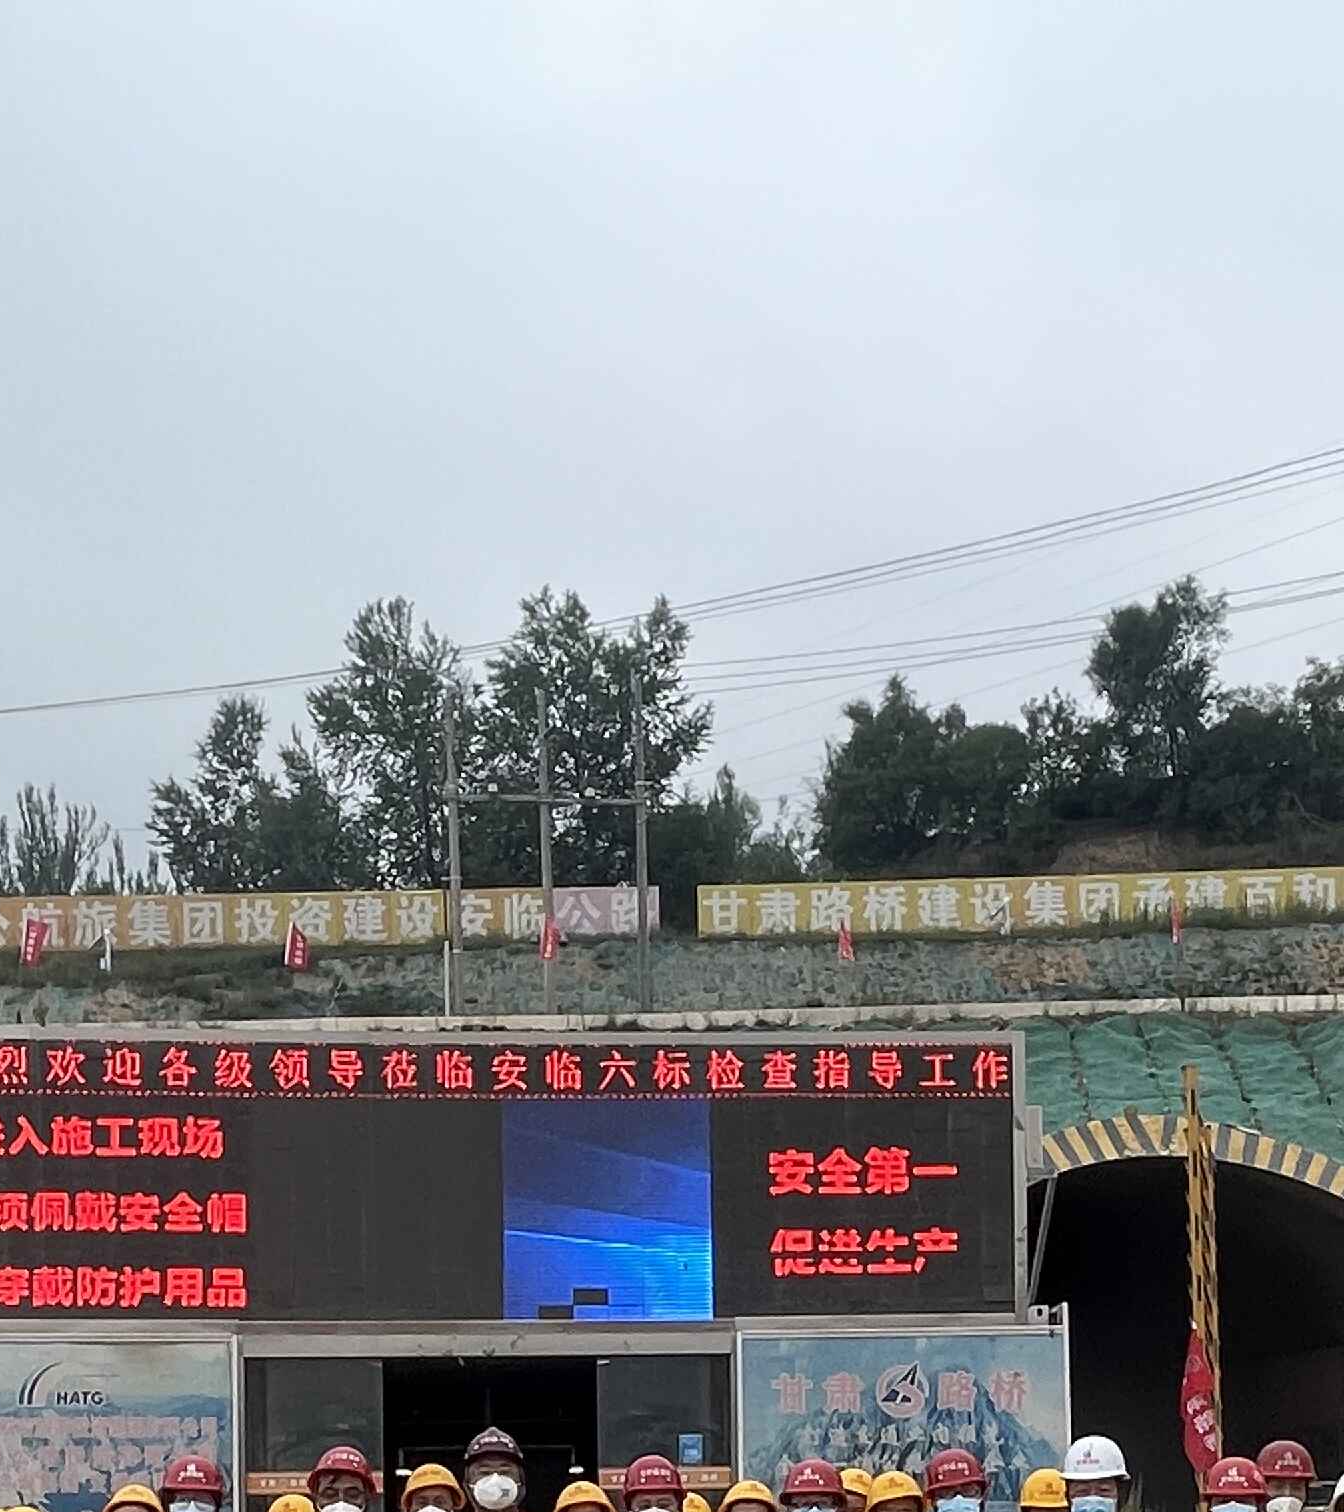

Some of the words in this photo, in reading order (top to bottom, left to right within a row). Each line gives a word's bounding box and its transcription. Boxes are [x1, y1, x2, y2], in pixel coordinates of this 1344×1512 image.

[768, 1146, 958, 1195] 安全第一
[770, 1226, 958, 1276] 促进生产
[55, 1391, 105, 1406] HATG
